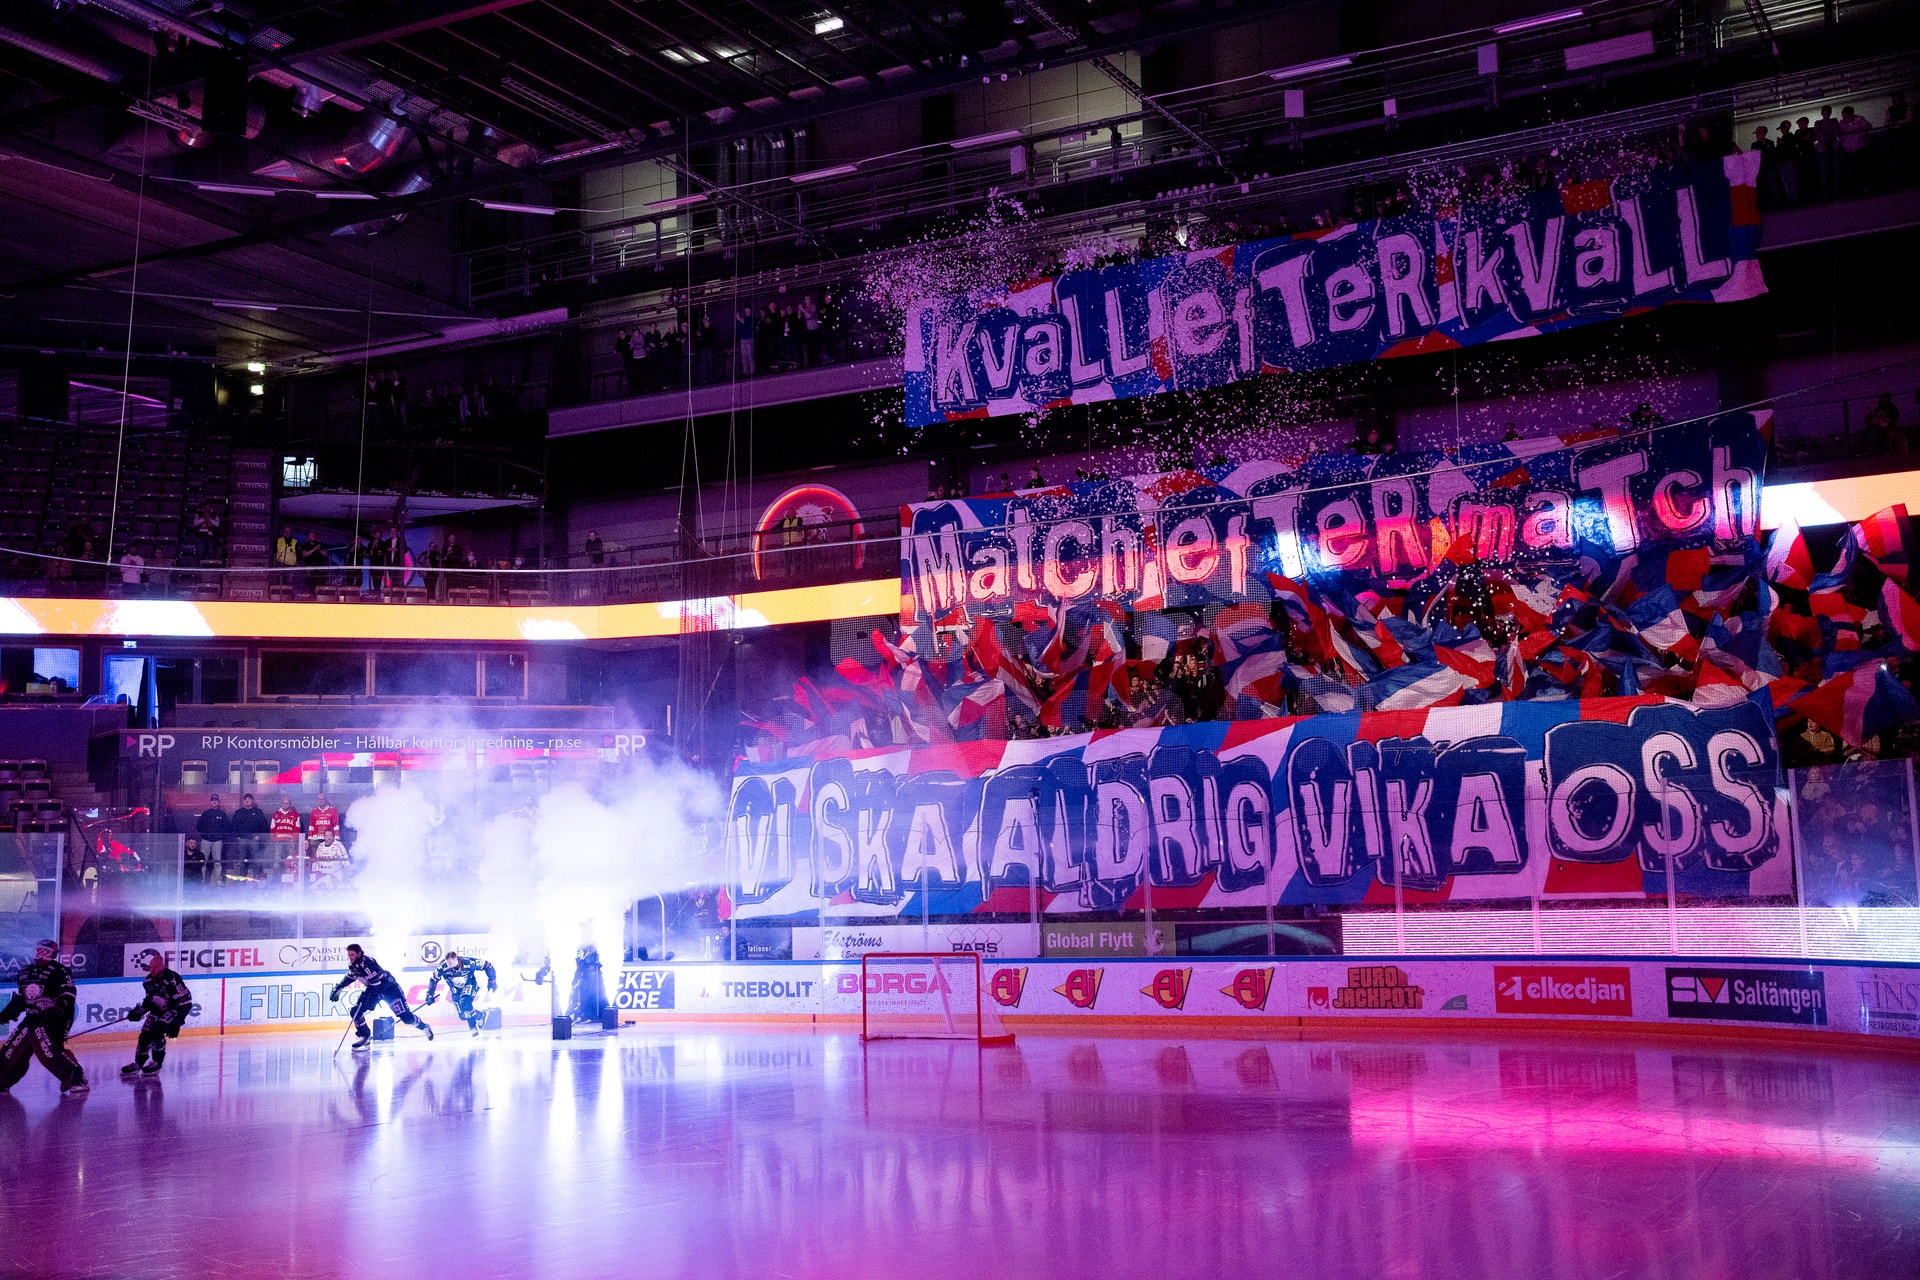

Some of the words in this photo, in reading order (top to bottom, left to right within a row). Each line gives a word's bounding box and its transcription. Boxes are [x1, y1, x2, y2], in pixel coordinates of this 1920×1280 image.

[138, 735, 175, 758] RP
[202, 736, 224, 749] RP
[227, 735, 340, 750] Kontorsmöbler
[356, 734, 409, 750] Hållbar
[412, 734, 534, 753] kontorsinredning
[548, 737, 582, 753] rp.se
[615, 735, 647, 756] RP
[736, 786, 792, 896] VI
[813, 780, 960, 893] SKA
[988, 773, 1268, 886] ALDRIG
[1300, 767, 1521, 877] VIKA
[1550, 729, 1772, 858] OSS
[952, 942, 998, 953] PARS
[1046, 931, 1095, 949] Global
[1100, 931, 1134, 949] Flytt
[619, 971, 668, 989] CKEY
[837, 973, 952, 994] BORGA
[1348, 966, 1398, 988] EURO
[618, 991, 660, 1009] ORE
[722, 981, 813, 998] TREBOLIT
[1332, 987, 1418, 1009] JACKPOT
[1733, 979, 1823, 1010] Saltängen
[1859, 981, 1920, 1011] FINS
